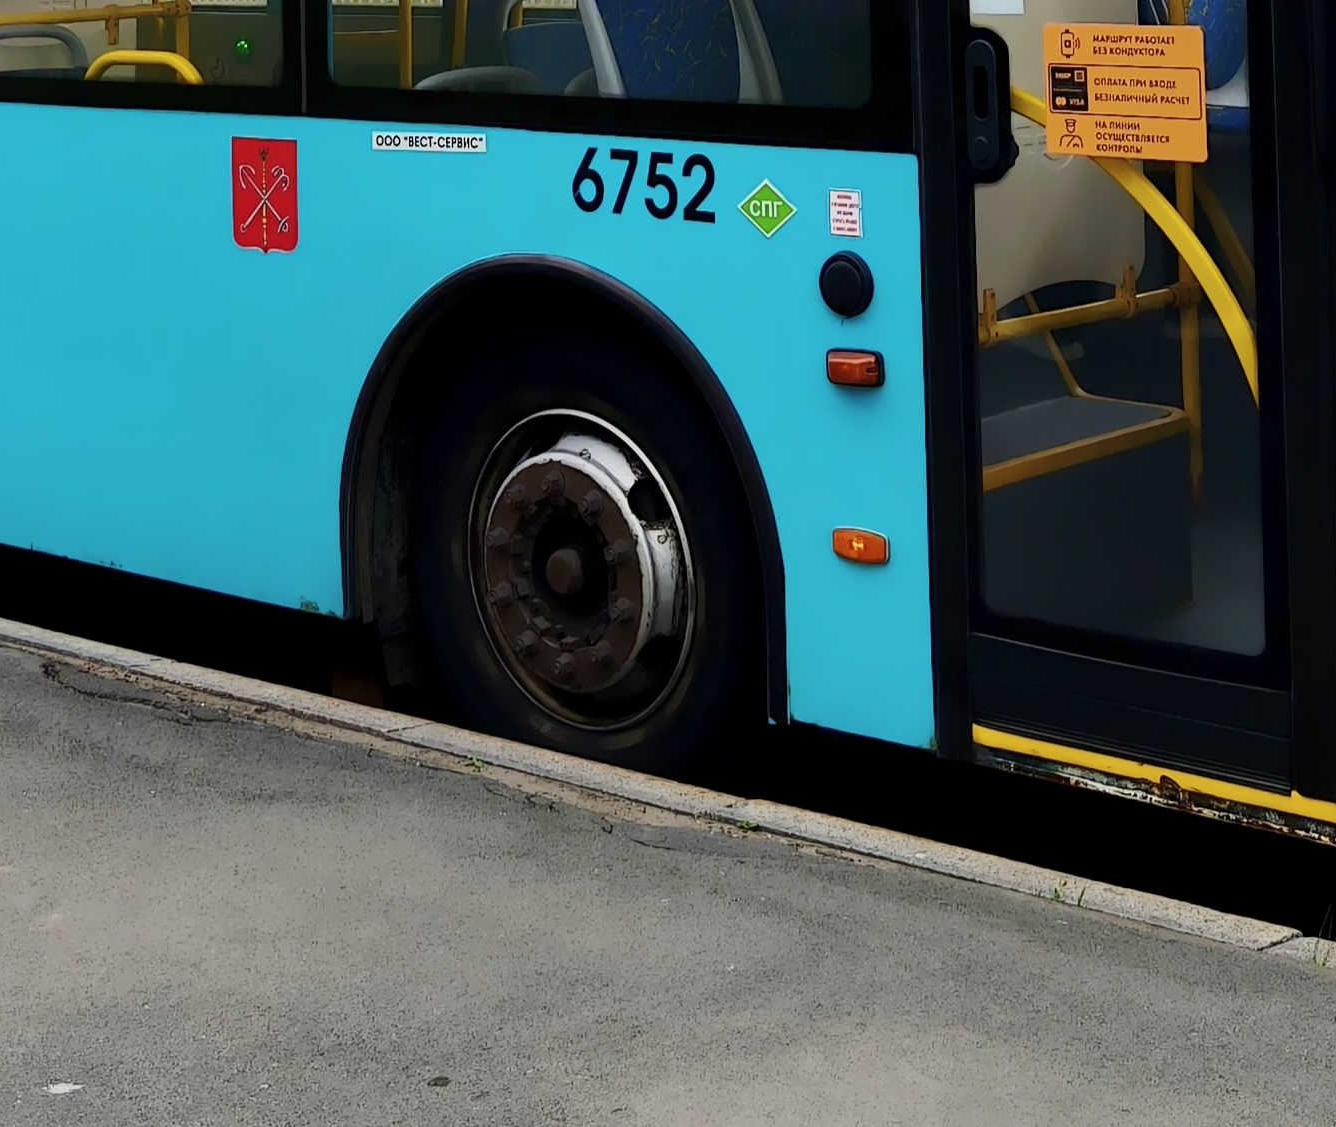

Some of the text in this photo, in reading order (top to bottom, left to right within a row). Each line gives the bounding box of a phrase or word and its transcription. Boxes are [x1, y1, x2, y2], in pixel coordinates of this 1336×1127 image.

[1093, 35, 1175, 45] МАРШРУТ РАБОТАЕТ
[1093, 46, 1165, 57] БЕЗ КОНДУКТОРА
[1093, 77, 1176, 89] ОПЛАТА ПРИ ВХОДЕ
[1094, 93, 1190, 105] БЕЗНАЛИЧНЫЙ РАСЧЕТ
[1095, 120, 1140, 131] НА ЛИНИИ
[376, 134, 483, 149] ООО "ВЕСТ-СЕРВИС"
[1095, 132, 1170, 143] ОСУЩЕСТВЛЯЕТСЯ
[572, 147, 716, 224] 6752
[749, 199, 783, 219] СПГ
